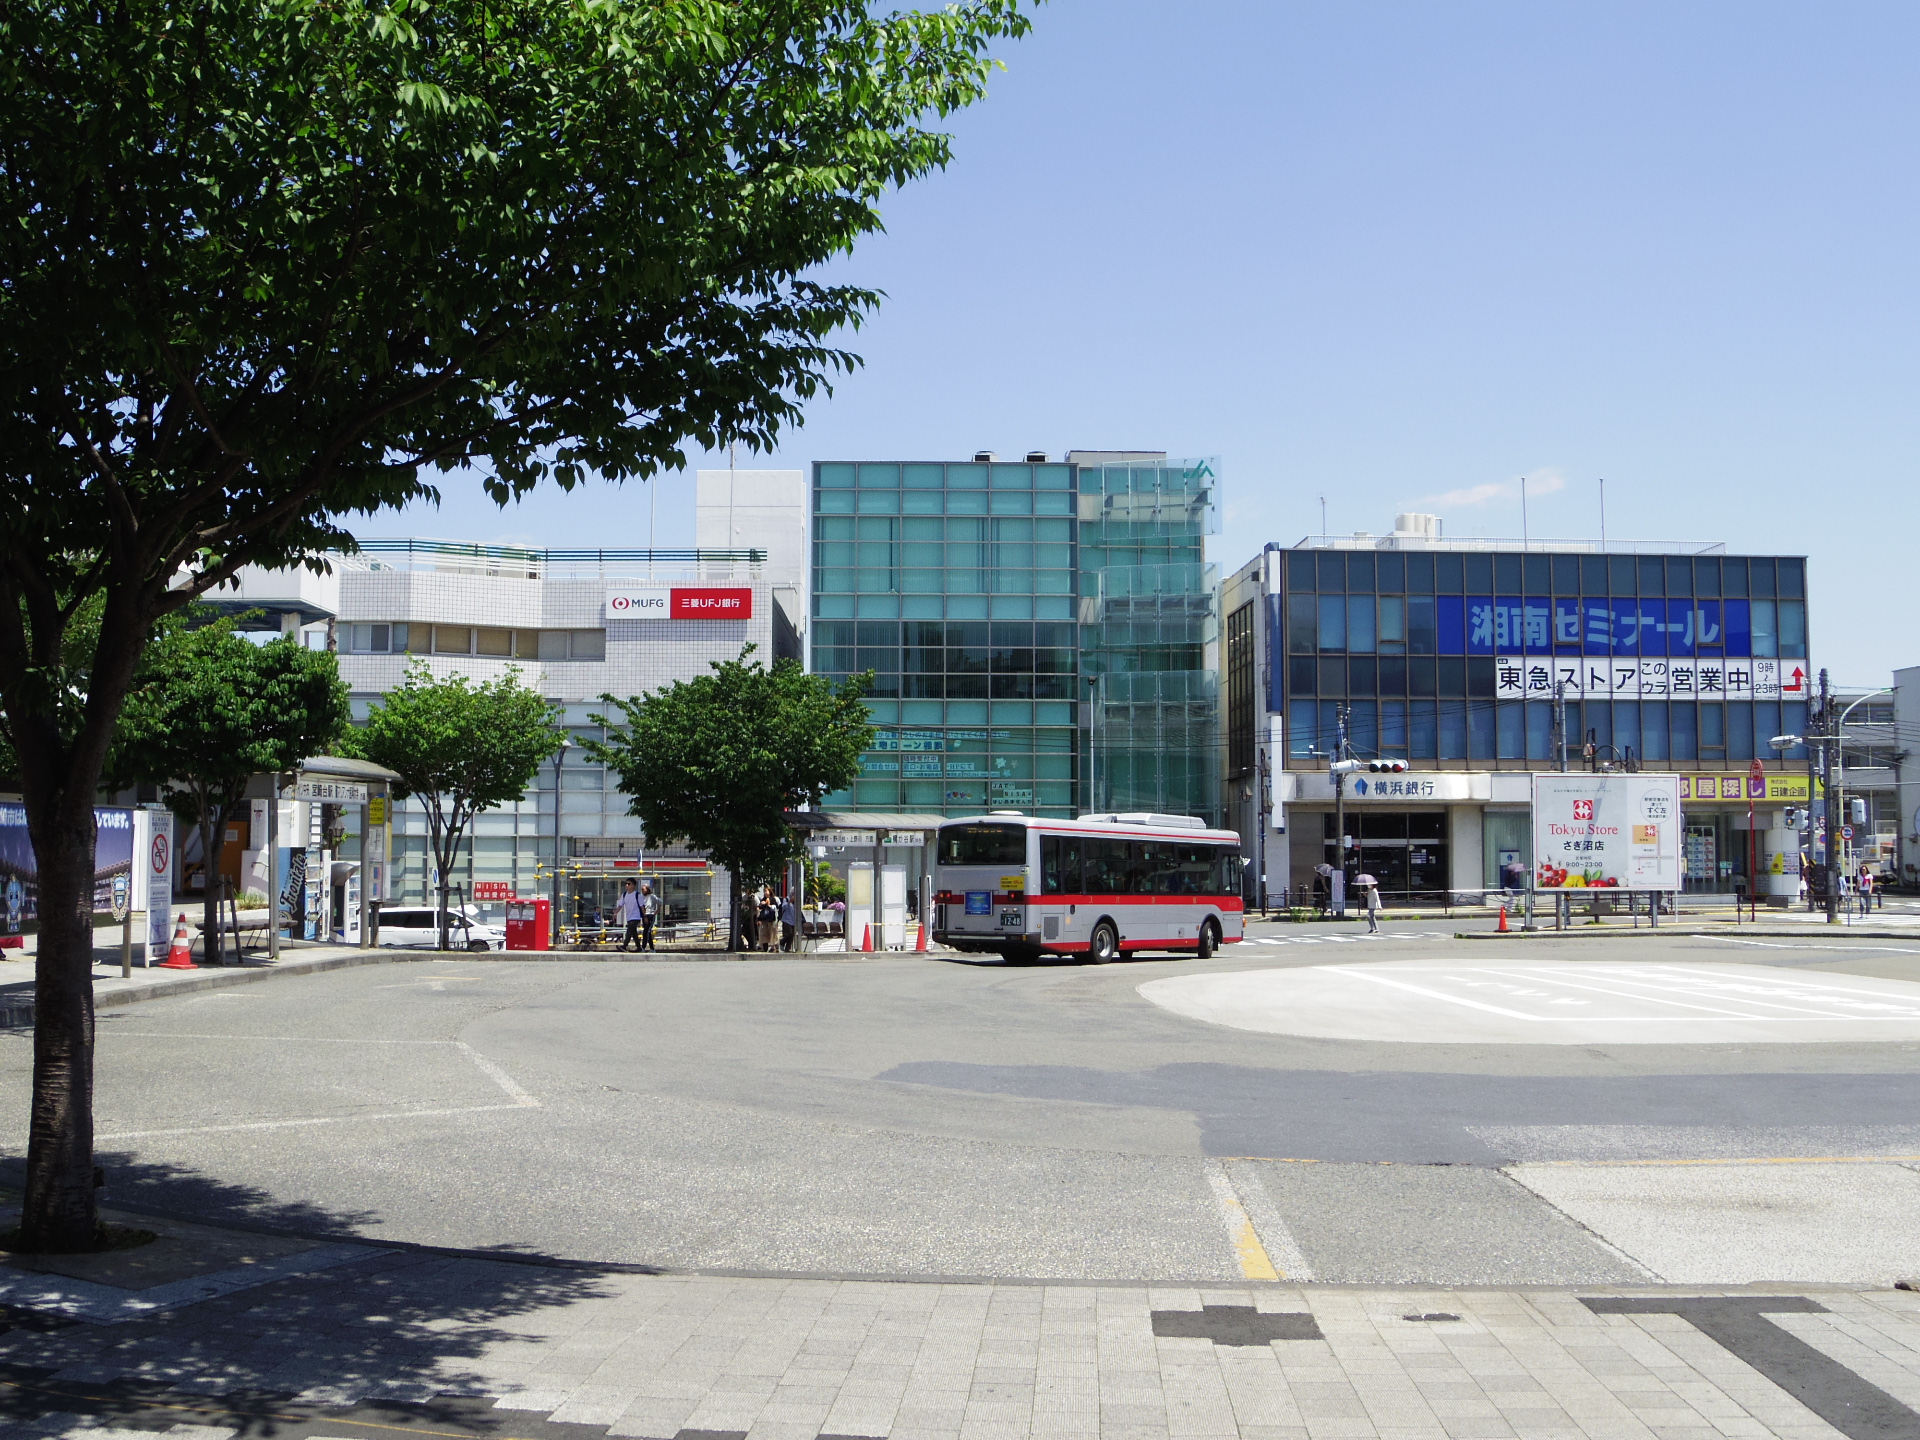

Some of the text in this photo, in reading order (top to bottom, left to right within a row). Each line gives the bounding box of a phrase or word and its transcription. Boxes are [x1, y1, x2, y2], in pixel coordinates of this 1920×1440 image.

[631, 598, 664, 608] MUFG
[681, 598, 740, 608] 三菱UFJ銀行
[1471, 605, 1720, 647] 湘南ゼミナール
[1641, 662, 1667, 675] この
[1757, 662, 1774, 673] 9時
[1498, 665, 1636, 690] 東急ストア
[1671, 667, 1749, 691] 営業中
[1641, 681, 1667, 694] ウラ
[1755, 683, 1778, 694] 23時
[1374, 781, 1435, 796] 横浜銀行
[1771, 787, 1807, 797] 日建企画
[1548, 823, 1619, 837] Tokyu Store
[1563, 841, 1605, 851] さぎ沼店
[280, 853, 308, 915] Frontale
[476, 882, 507, 890] NISA
[1004, 917, 1021, 925] 12-48
